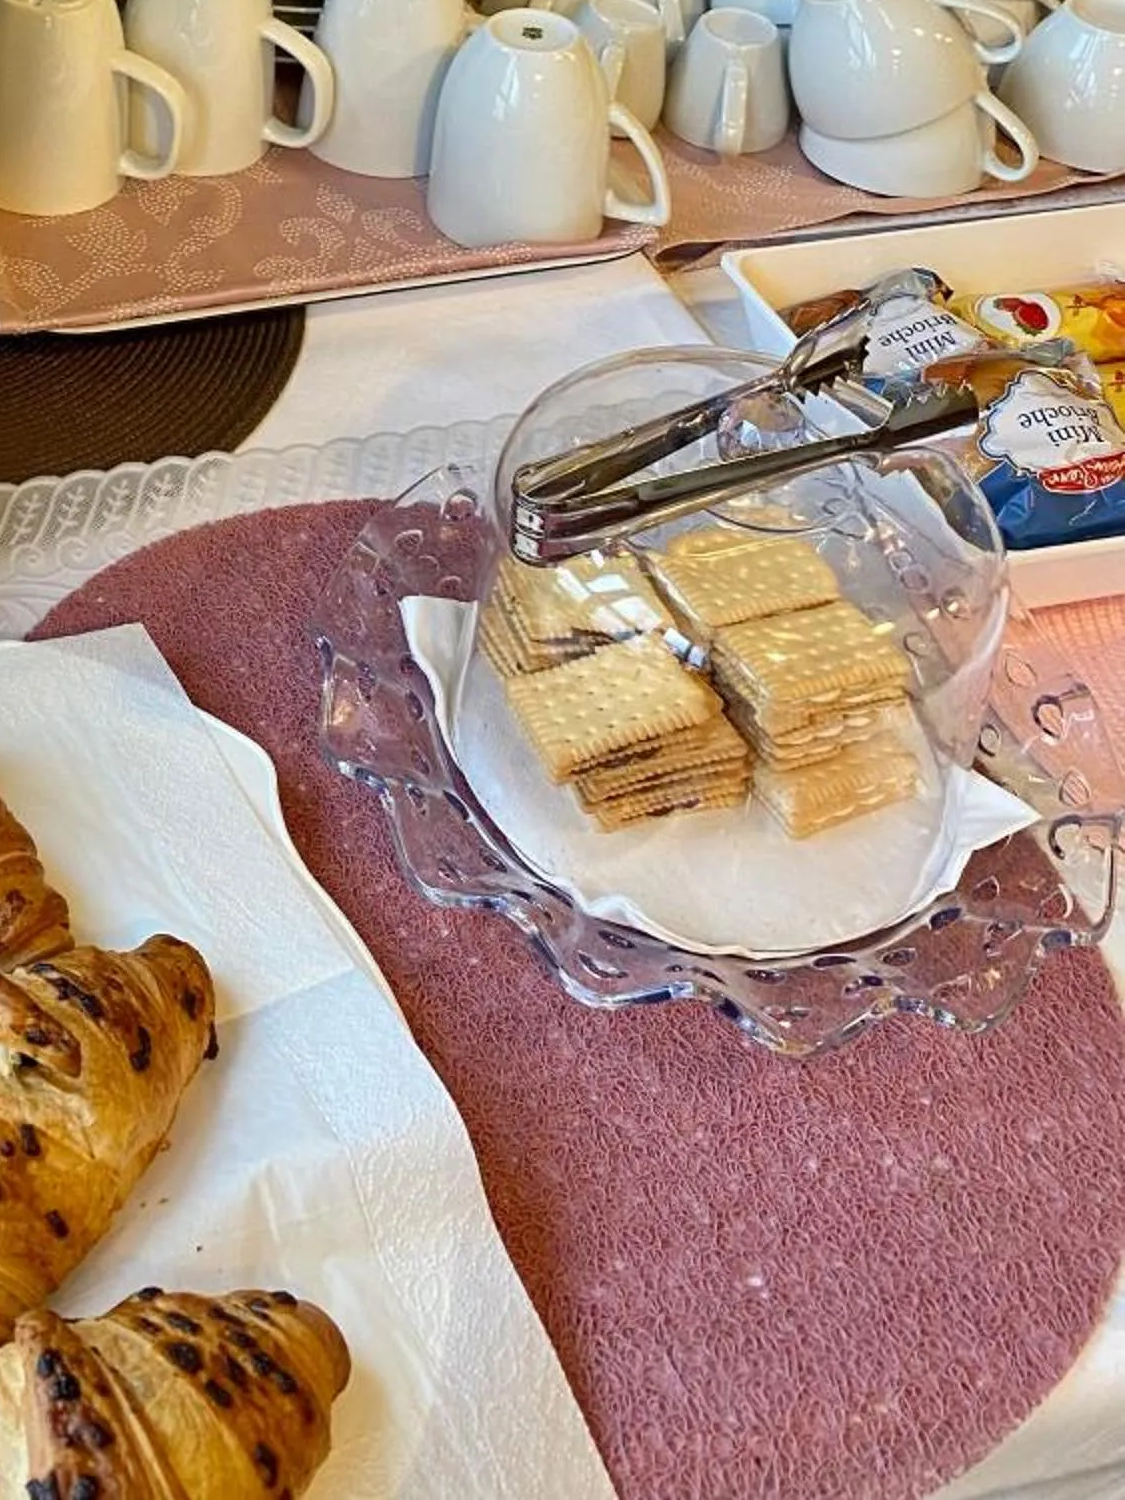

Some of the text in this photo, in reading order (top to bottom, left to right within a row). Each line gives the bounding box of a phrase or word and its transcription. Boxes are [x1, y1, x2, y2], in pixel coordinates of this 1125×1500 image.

[877, 313, 958, 347] Brioche
[1017, 404, 1101, 429] Brioche
[1046, 425, 1105, 448] Mini
